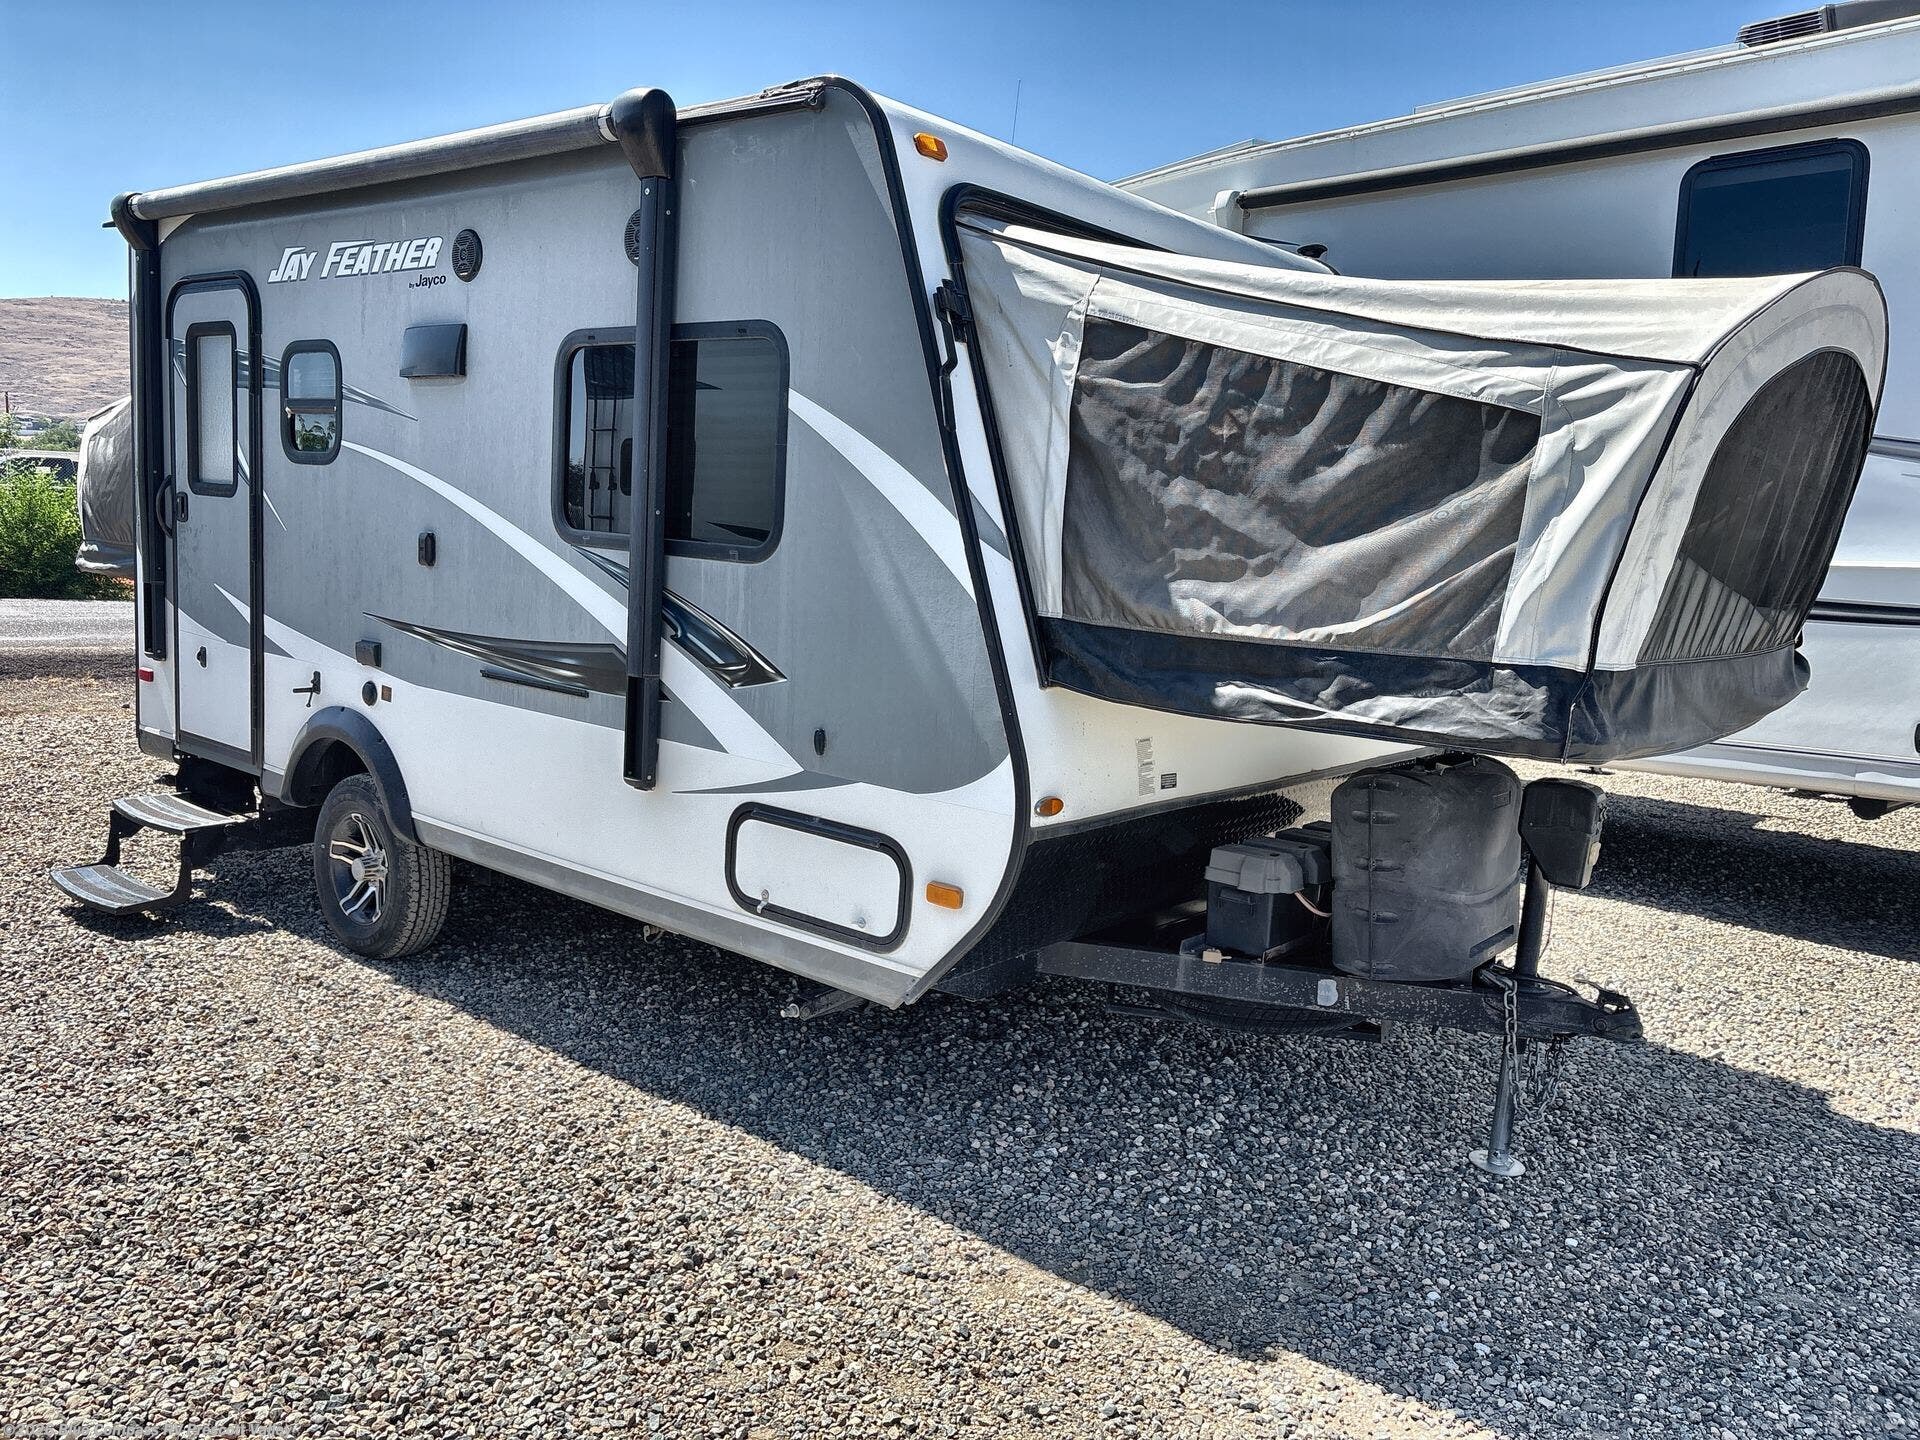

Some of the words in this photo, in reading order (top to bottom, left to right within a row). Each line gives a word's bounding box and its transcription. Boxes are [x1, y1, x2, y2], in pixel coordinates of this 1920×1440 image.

[267, 246, 318, 284] JAY
[319, 236, 443, 280] FEATHER
[415, 273, 447, 289] Jayco
